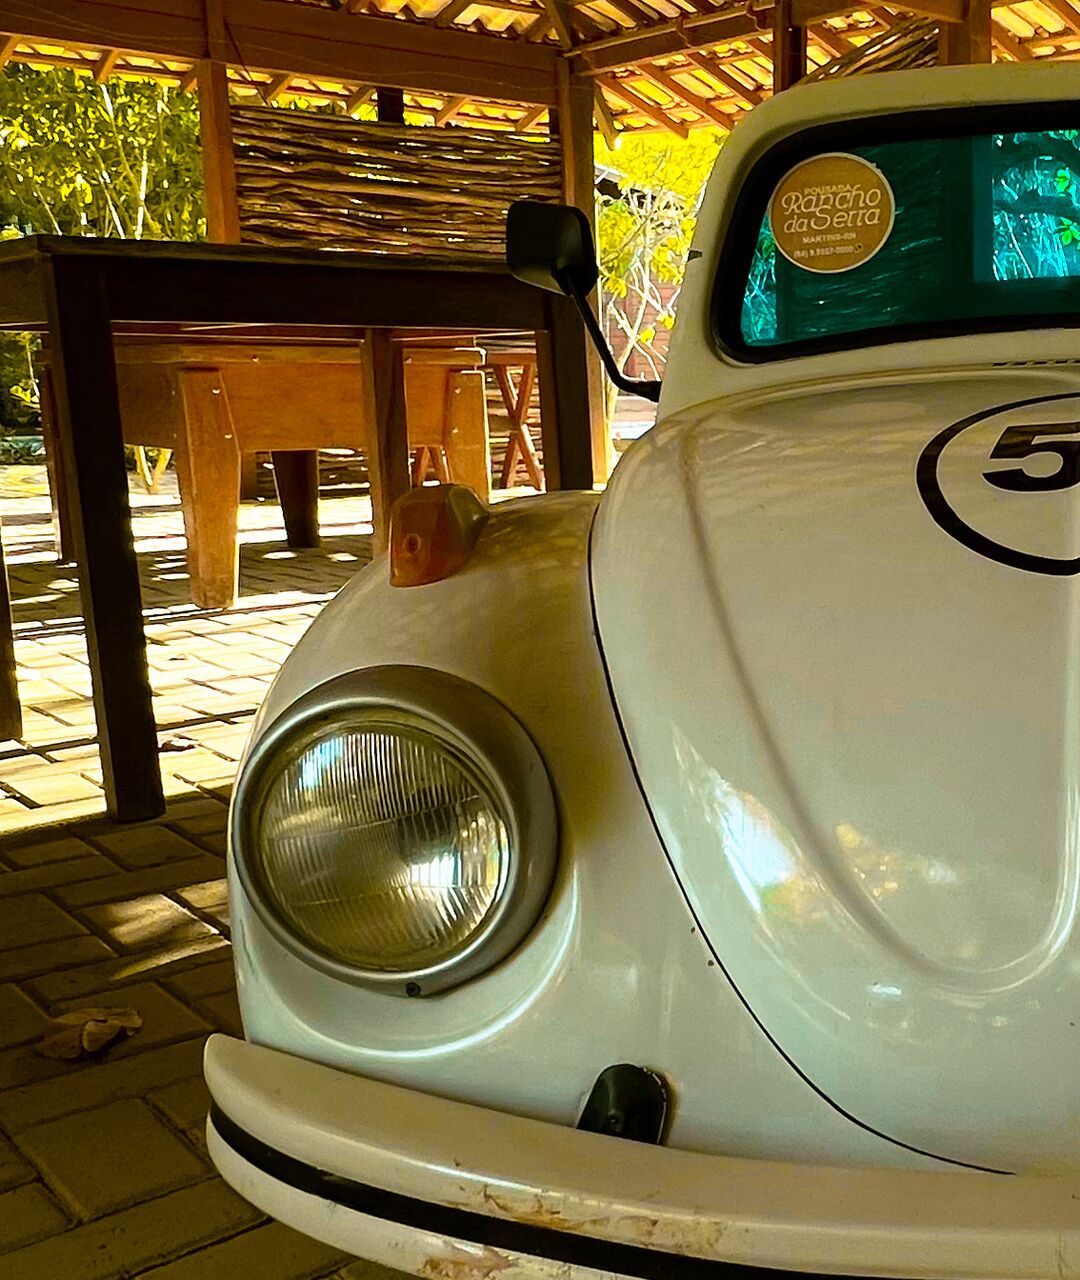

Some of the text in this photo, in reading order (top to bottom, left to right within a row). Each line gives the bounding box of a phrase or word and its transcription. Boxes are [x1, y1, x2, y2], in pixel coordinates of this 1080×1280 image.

[781, 184, 881, 215] Rancho
[803, 184, 852, 195] POUSADA
[784, 205, 880, 233] da Serra
